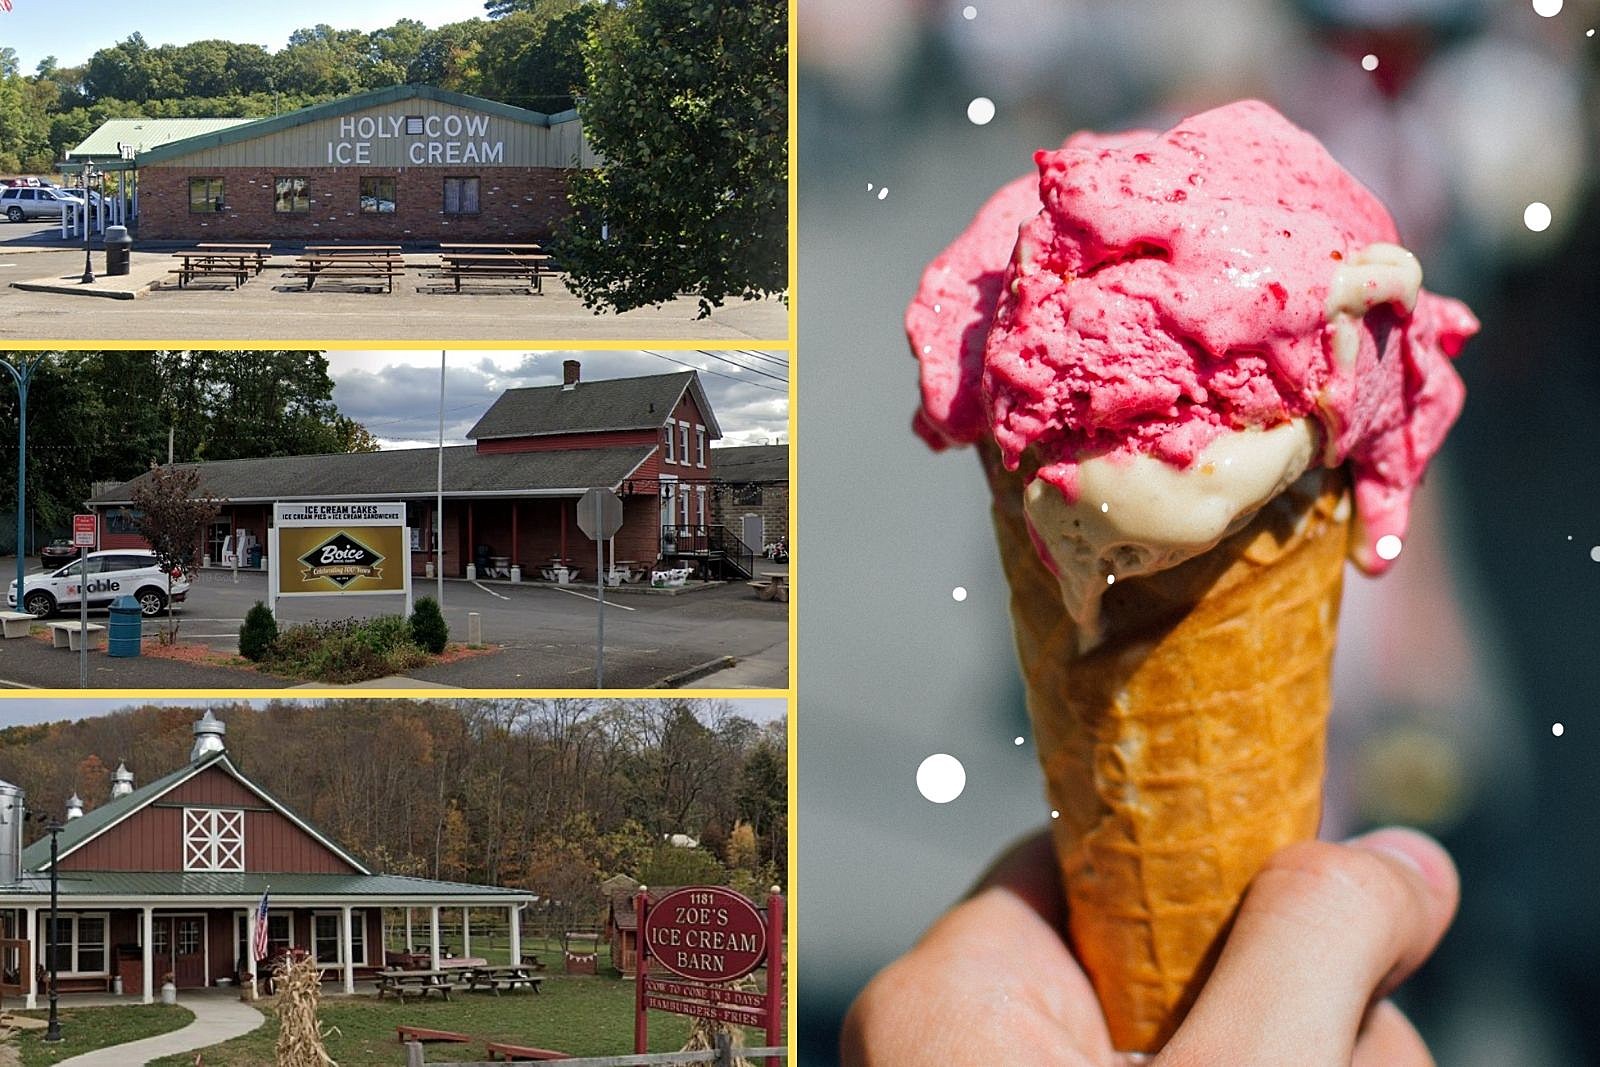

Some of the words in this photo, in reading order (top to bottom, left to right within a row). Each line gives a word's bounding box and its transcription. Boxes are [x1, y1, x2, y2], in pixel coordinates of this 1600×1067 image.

[340, 116, 405, 139] HOLY
[425, 115, 490, 137] COW
[327, 142, 371, 164] ICE
[409, 142, 503, 164] CREAM
[305, 506, 318, 514] ICE
[320, 506, 349, 514] CREAM
[351, 506, 378, 514] CAKES
[320, 544, 365, 564] Boice
[690, 894, 714, 905] 1181
[675, 907, 729, 926] ZOE'S
[652, 927, 681, 946] ICE
[686, 930, 757, 952] CREAM
[677, 952, 725, 972] BARN
[711, 990, 721, 1000] IN
[724, 992, 731, 1002] 3
[649, 998, 717, 1018] HAMBURGERS
[724, 1010, 758, 1025] FRIES
